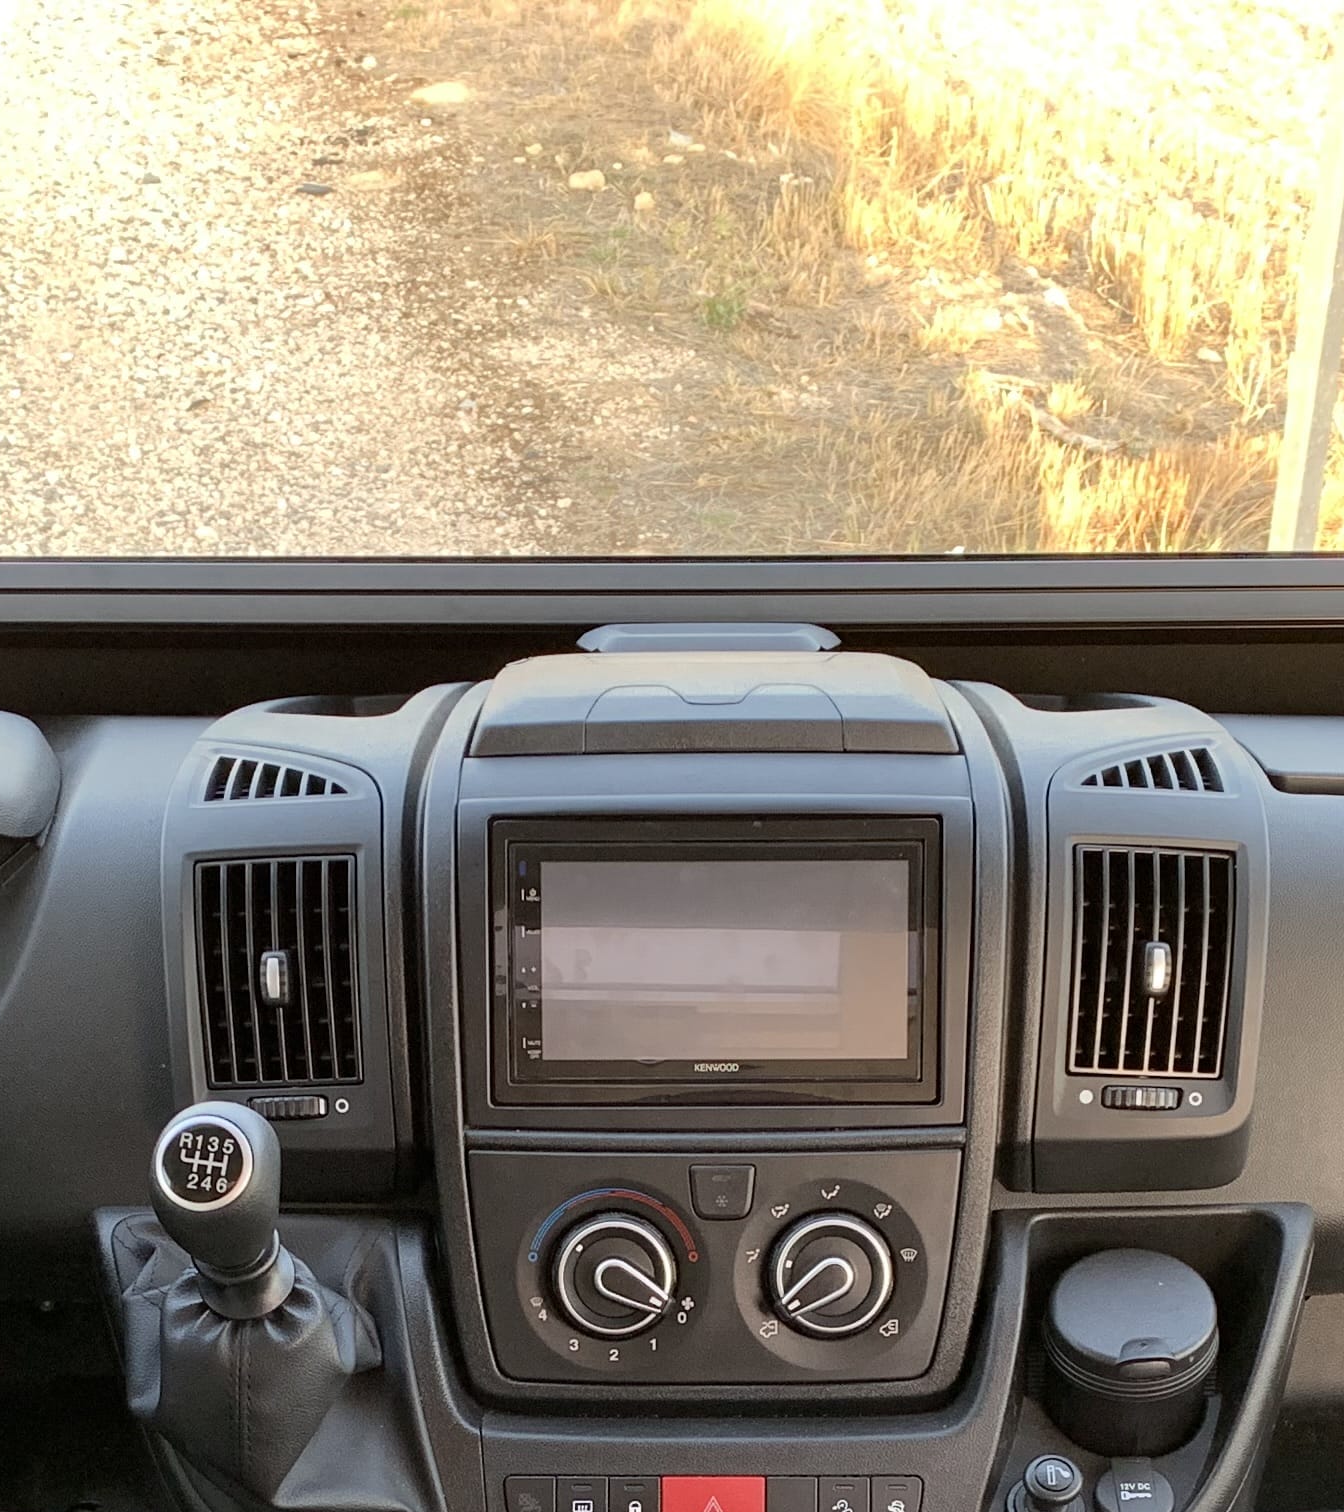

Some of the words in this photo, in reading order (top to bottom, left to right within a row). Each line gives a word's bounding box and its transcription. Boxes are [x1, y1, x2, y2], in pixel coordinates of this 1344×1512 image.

[694, 1063, 740, 1072] KENWOOD
[179, 1132, 193, 1149] R
[195, 1134, 204, 1150] 1
[207, 1136, 220, 1152] 3
[222, 1138, 235, 1154] 5
[186, 1173, 199, 1189] 2
[200, 1175, 212, 1191] 4
[216, 1177, 228, 1194] 6
[538, 1308, 548, 1321] 4
[569, 1338, 579, 1351] 3
[649, 1338, 657, 1351] 1
[609, 1348, 619, 1361] 2
[1119, 1482, 1136, 1490] 12V
[1137, 1482, 1151, 1490] DC
